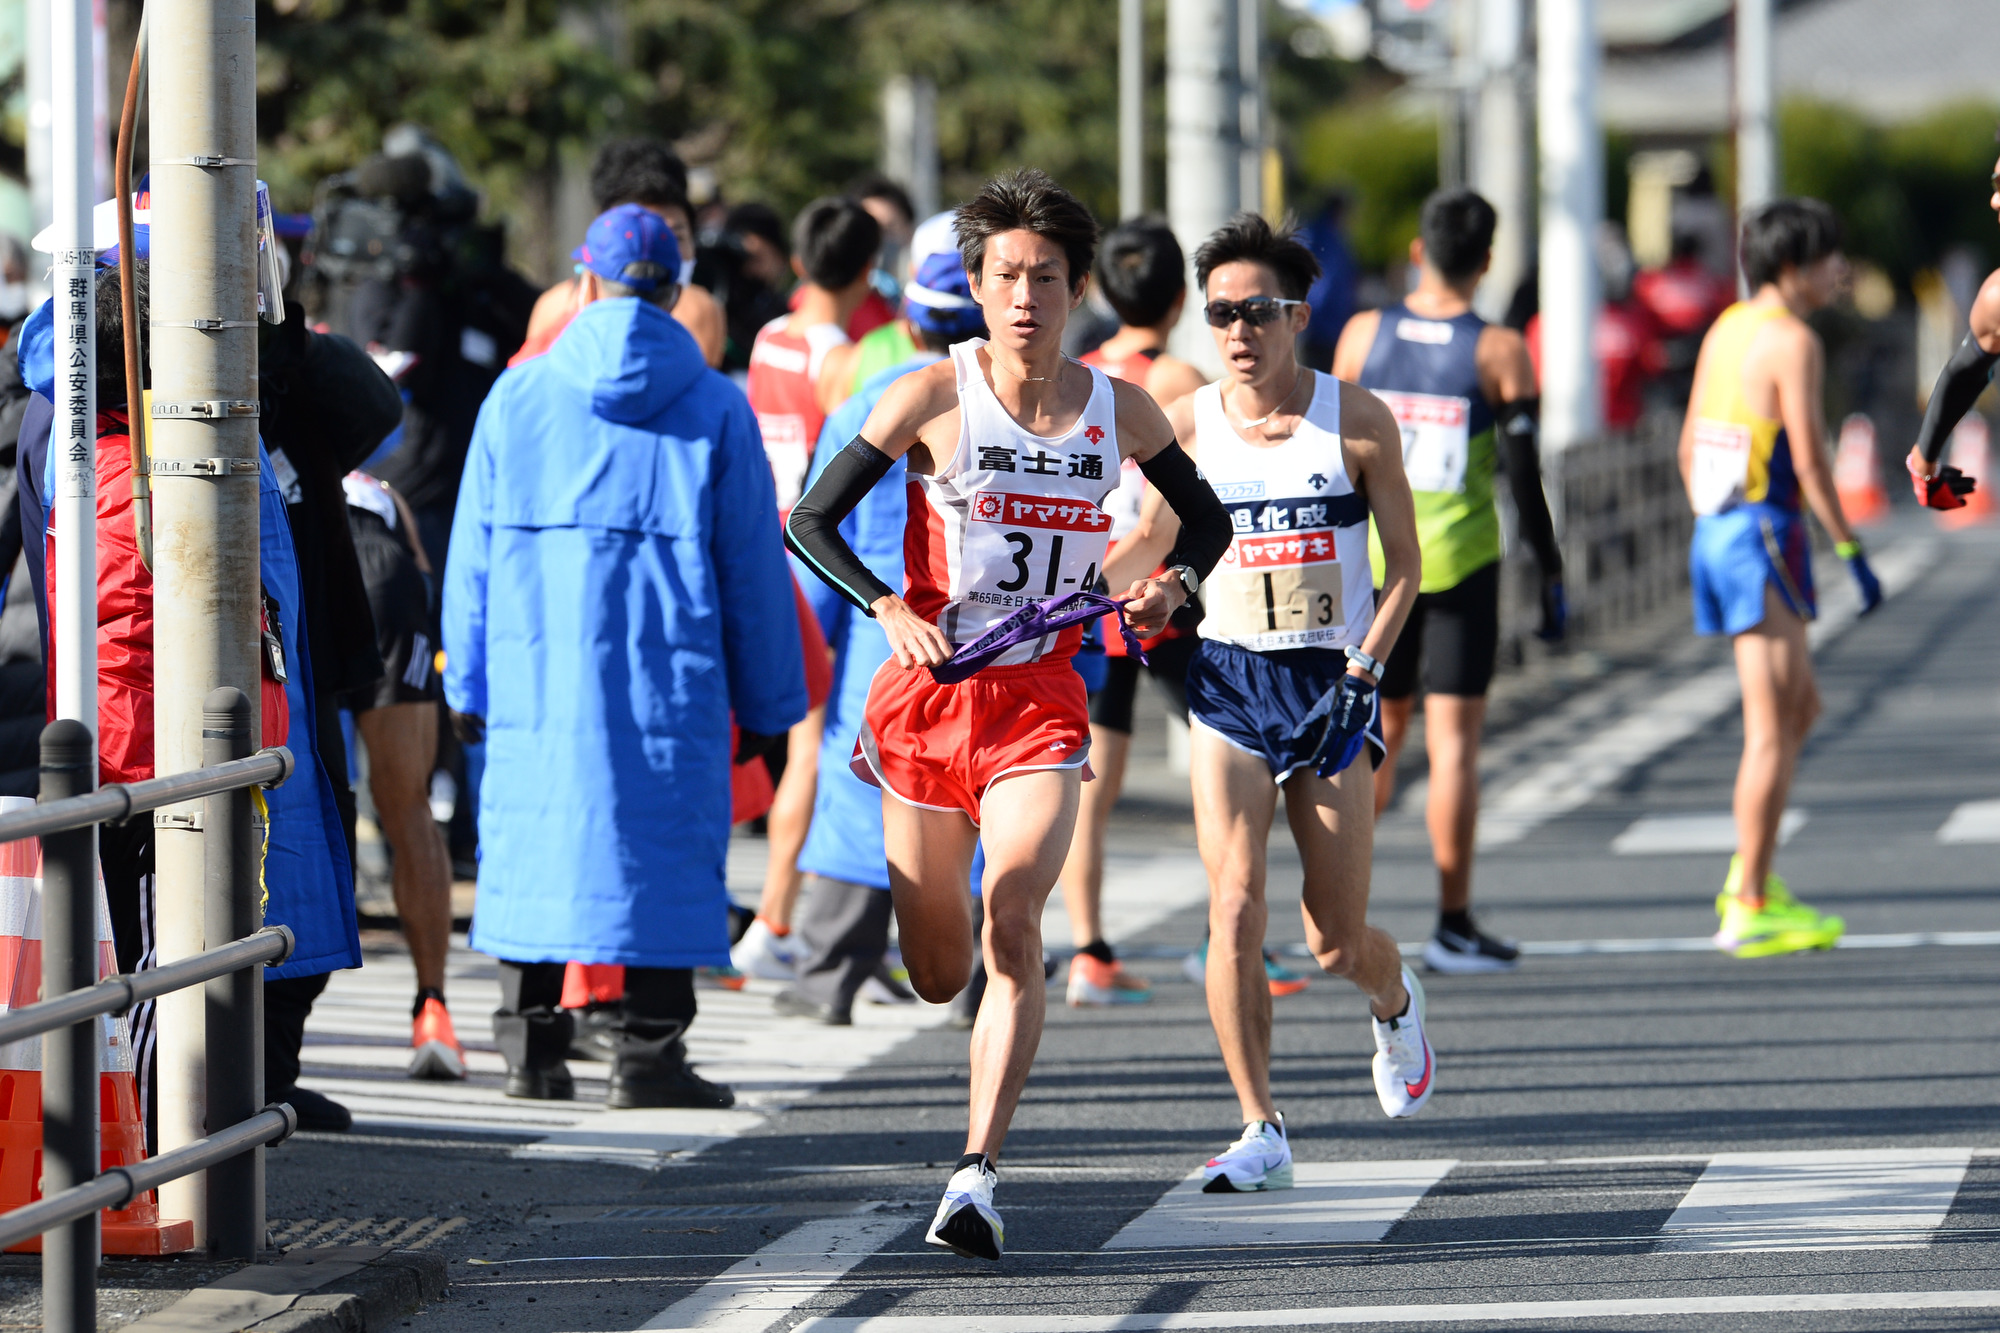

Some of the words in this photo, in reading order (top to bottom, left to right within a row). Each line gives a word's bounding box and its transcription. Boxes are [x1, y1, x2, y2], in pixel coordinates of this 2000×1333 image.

[69, 278, 87, 462] 群馬県公安委員会
[977, 446, 1104, 480] 富士通
[1011, 500, 1105, 526] ヤマザキ
[1230, 504, 1327, 532] 旭化成
[1242, 537, 1330, 563] ヤマザキ
